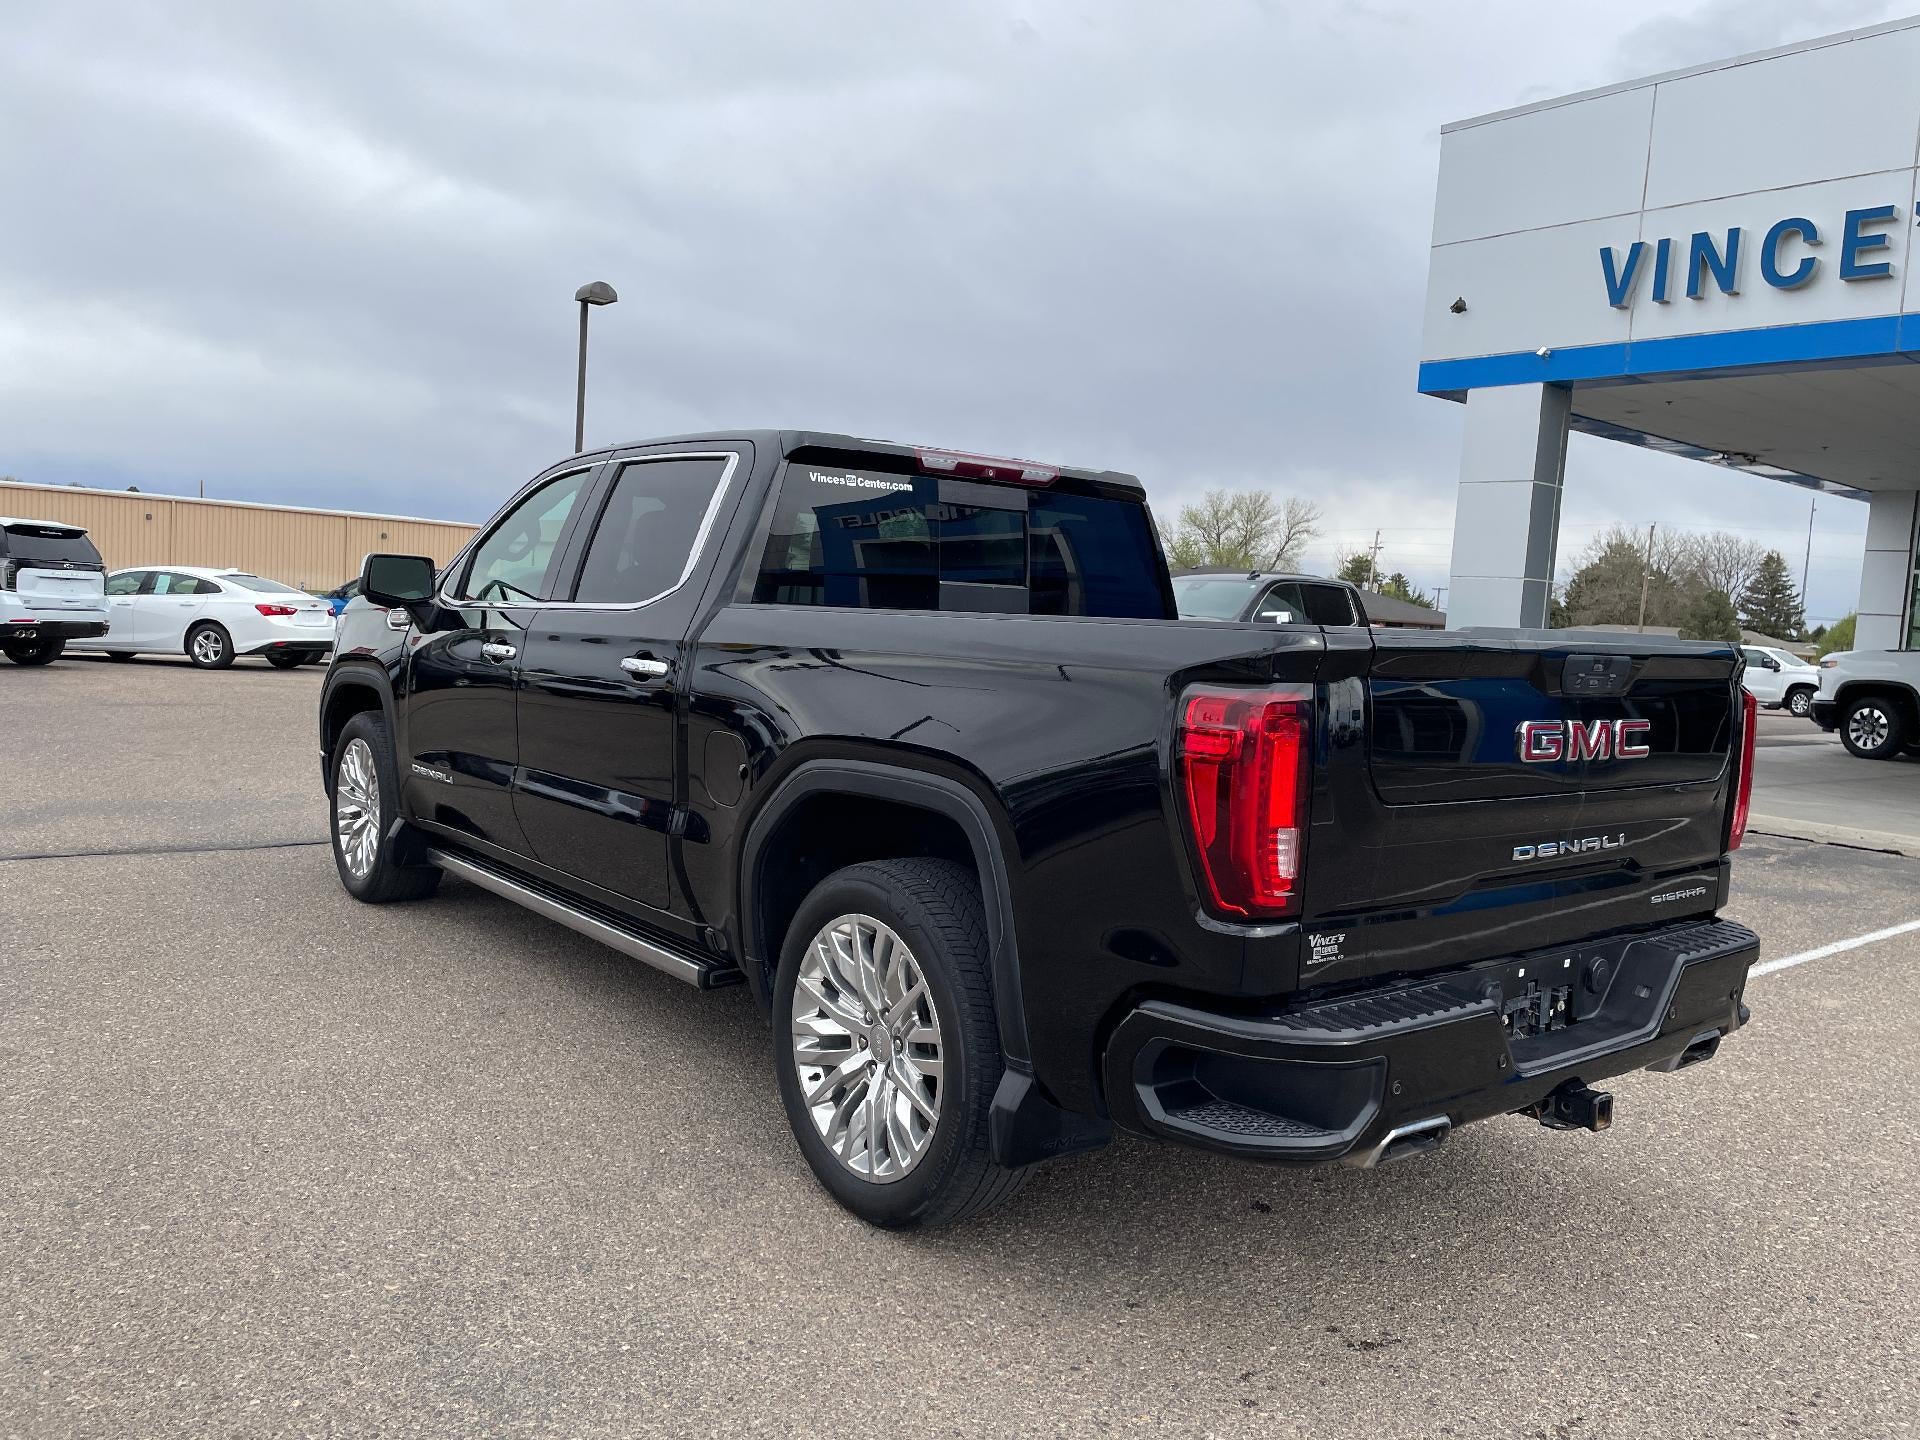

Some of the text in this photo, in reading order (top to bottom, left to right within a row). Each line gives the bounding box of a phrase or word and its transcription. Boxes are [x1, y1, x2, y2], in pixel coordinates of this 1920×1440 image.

[1516, 719, 1651, 763] GMC
[412, 763, 454, 785] DENALI
[1512, 832, 1625, 861] DENALI
[1650, 886, 1707, 904] SIERRA
